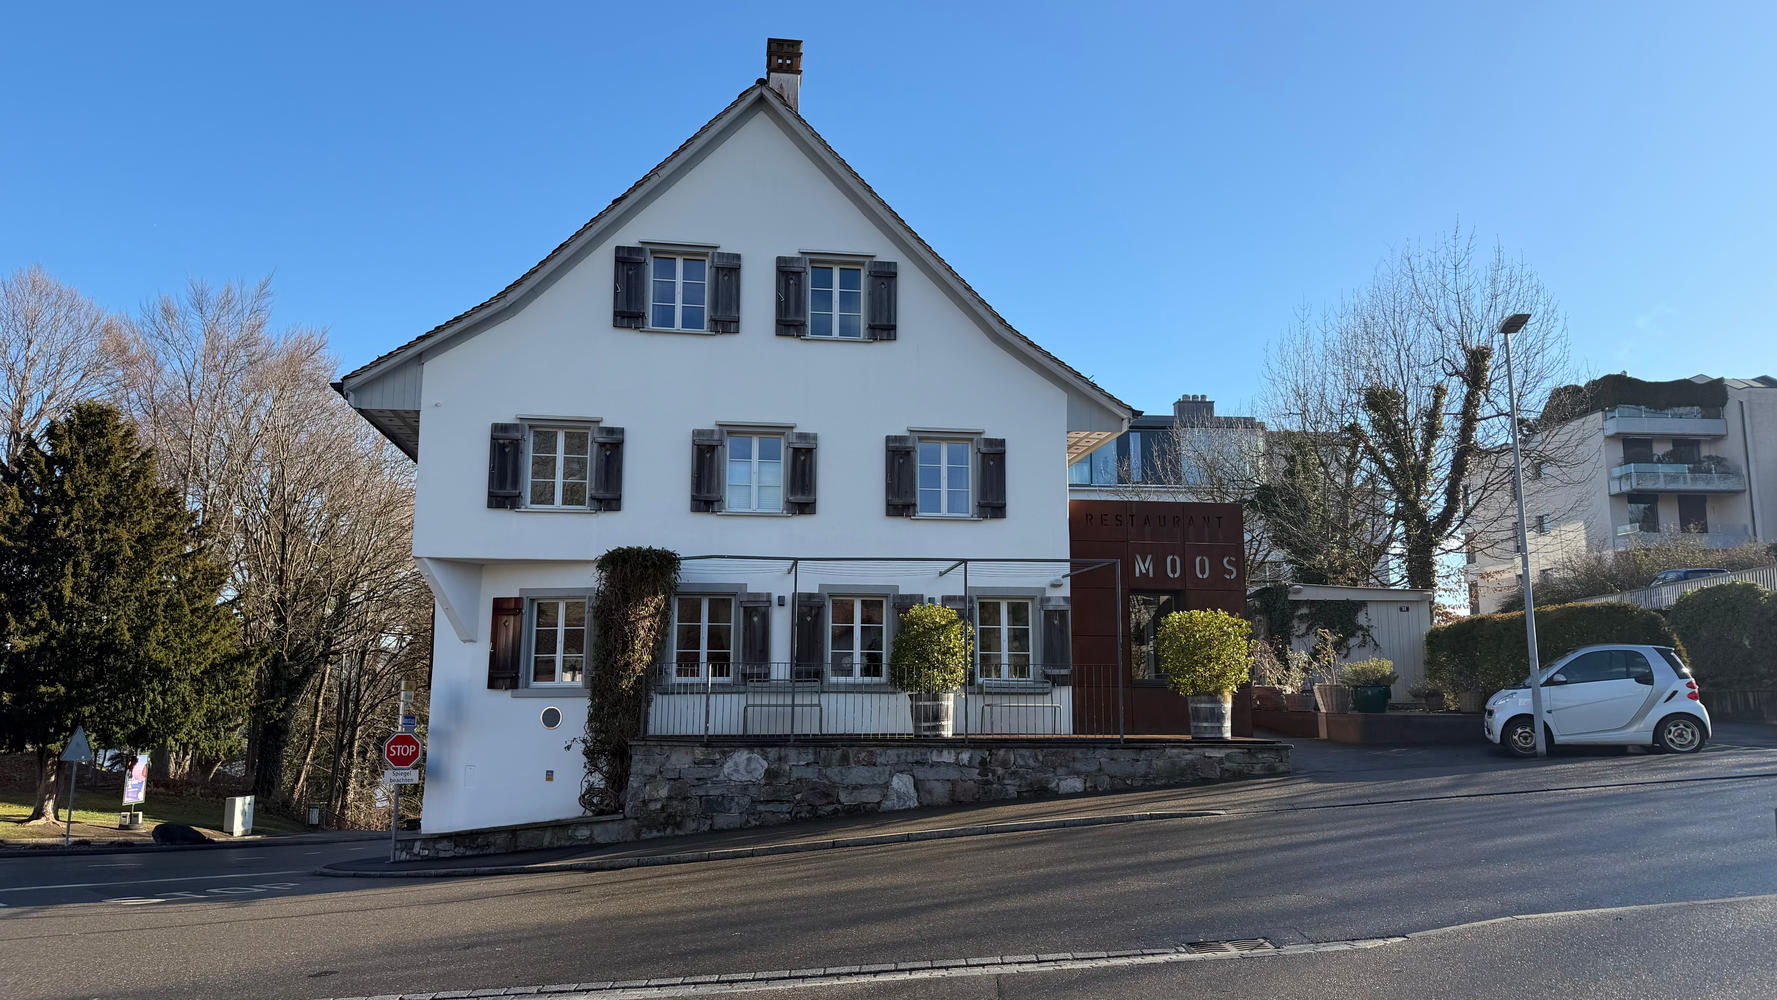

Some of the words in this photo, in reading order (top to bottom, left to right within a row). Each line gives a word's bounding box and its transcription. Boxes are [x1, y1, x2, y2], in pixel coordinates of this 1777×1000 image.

[1085, 513, 1224, 529] RESTAURANT
[1135, 553, 1238, 580] MOOS
[389, 744, 417, 757] STOP
[392, 770, 412, 778] Spiegel
